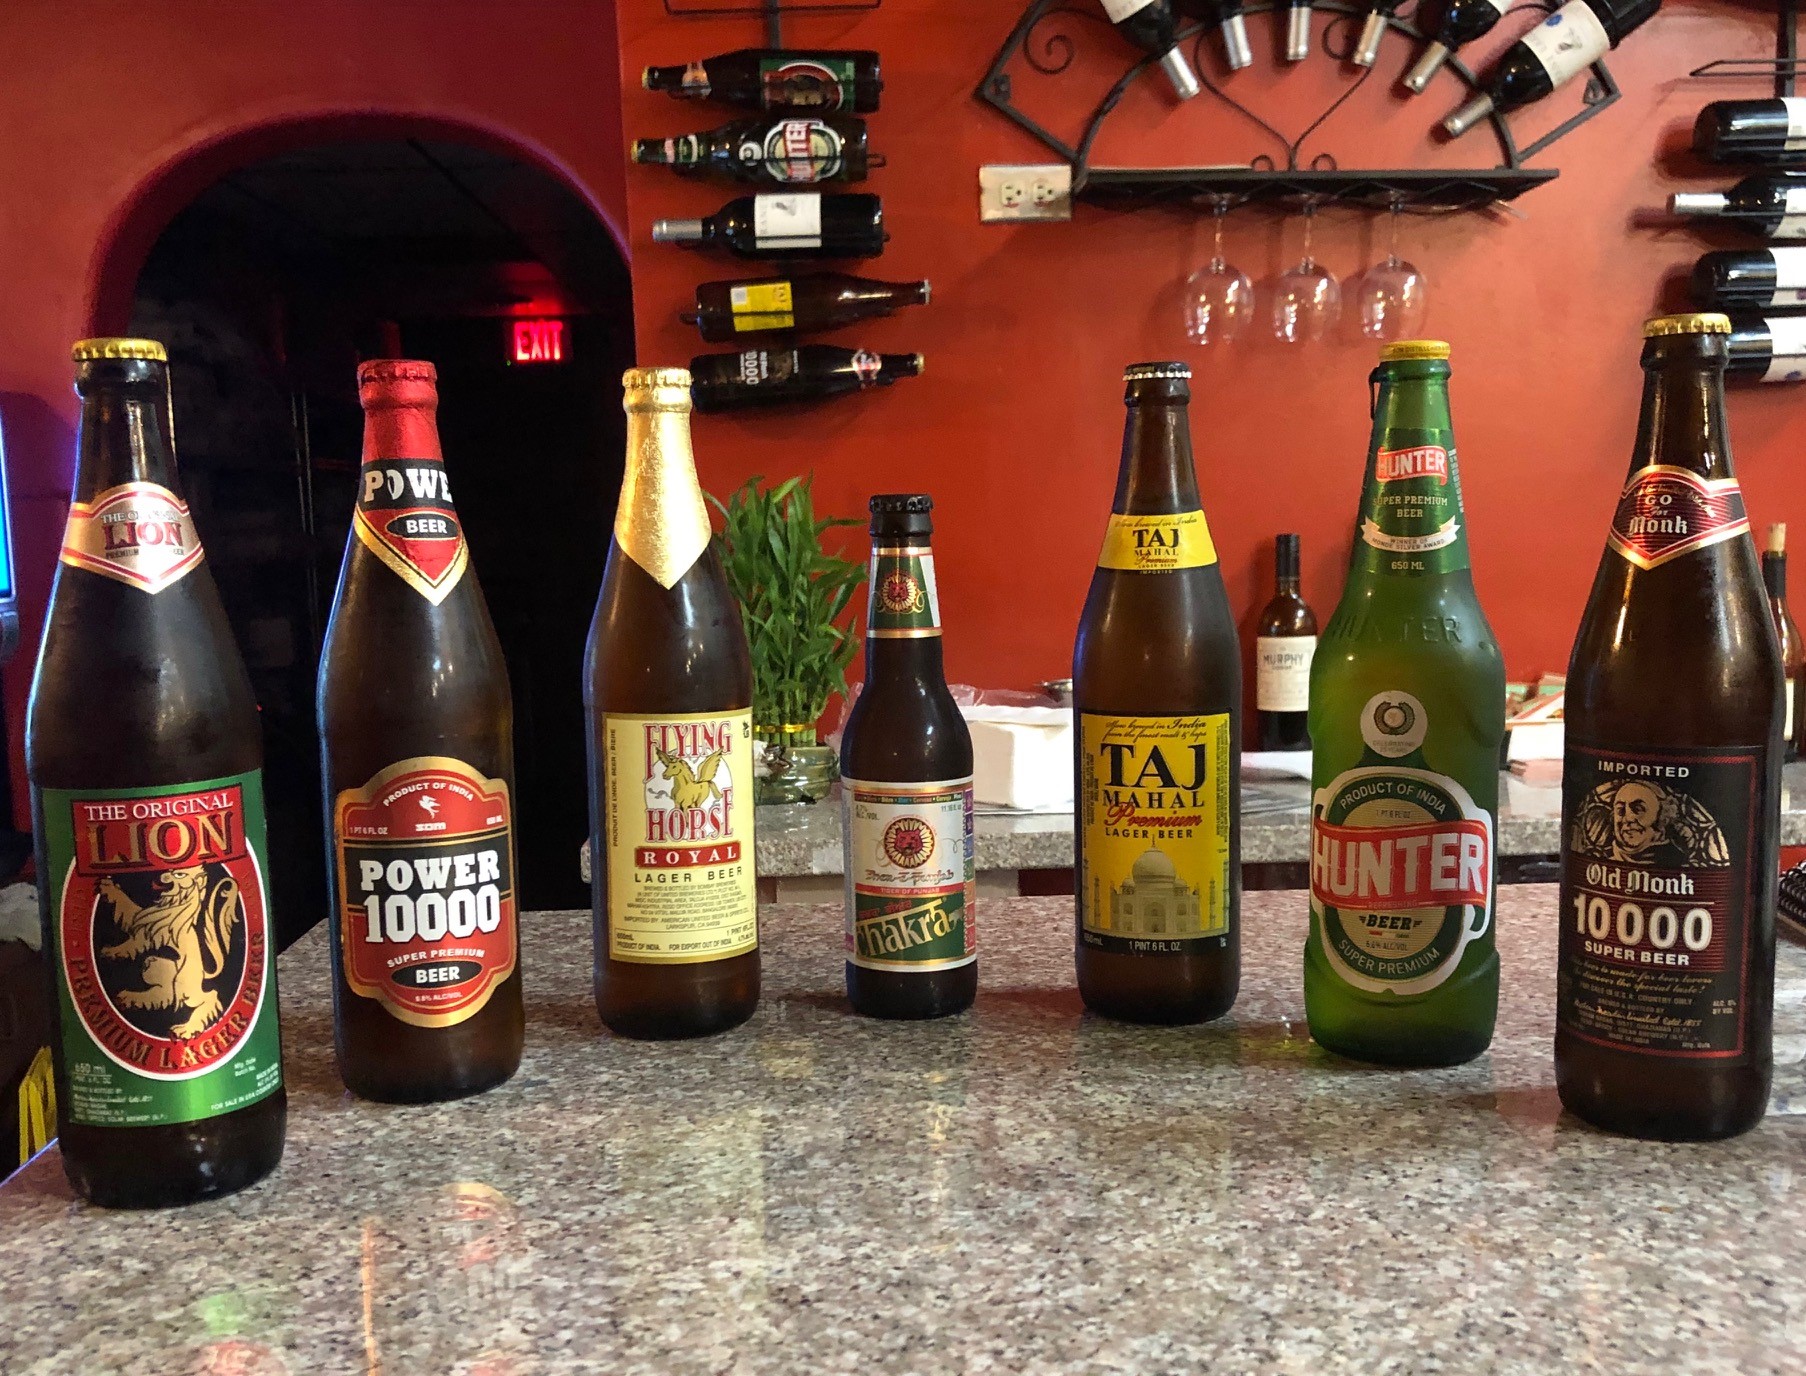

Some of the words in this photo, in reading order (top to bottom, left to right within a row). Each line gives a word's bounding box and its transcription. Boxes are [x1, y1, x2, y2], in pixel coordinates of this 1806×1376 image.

[514, 321, 563, 360] EXIT
[1374, 496, 1402, 506] SUPER
[1404, 496, 1448, 506] PREMIUM
[1645, 494, 1672, 505] GO
[101, 512, 126, 523] THE
[1396, 509, 1423, 518] BEER
[406, 520, 448, 534] BEER
[1628, 516, 1688, 536] Monk
[103, 522, 183, 550] LION
[1132, 528, 1179, 548] TAJ
[1423, 539, 1444, 549] AWARD
[1134, 548, 1178, 556] MAHAL
[1392, 562, 1409, 570] 650
[1411, 562, 1424, 570] ML
[1264, 654, 1304, 665] MURPHY
[1167, 718, 1206, 730] India
[643, 721, 732, 783] FLYING
[1100, 743, 1207, 790] TAJ
[1598, 760, 1690, 778] IMPORTED
[383, 782, 430, 806] PRODUCT
[432, 782, 446, 790] OF
[449, 784, 474, 802] INDIA
[1102, 790, 1204, 808] MAHAL
[1340, 782, 1392, 810] PRODUCT
[1397, 783, 1414, 796] OF
[1416, 790, 1447, 814] INDIA
[84, 804, 128, 822] THE
[132, 792, 234, 818] ORIGINAL
[612, 802, 618, 813] DE
[646, 788, 734, 842] HORSE
[1104, 802, 1202, 828] Premium
[87, 810, 233, 868] LION
[1106, 828, 1148, 838] LAGER
[1158, 830, 1192, 838] BEER
[643, 846, 737, 864] ROYAL
[1314, 831, 1484, 897] HUNTER
[360, 850, 500, 892] POWER
[634, 873, 692, 883] LAGER
[707, 866, 742, 880] BEER
[1586, 862, 1622, 890] Old
[1625, 870, 1694, 896] Monk
[364, 884, 500, 942] 10000
[1366, 914, 1413, 930] BEER
[1574, 892, 1712, 951] 10000
[617, 941, 638, 950] PRODUCT
[680, 942, 702, 950] EXPORT
[1134, 942, 1151, 950] PINT
[1152, 942, 1158, 950] 6
[1584, 940, 1635, 962] SUPER
[1640, 951, 1690, 966] BEER
[386, 950, 428, 968] SUPER
[430, 948, 485, 958] PREMIUM
[1339, 940, 1374, 971] SUPER
[1378, 948, 1440, 974] PREMIUM
[416, 966, 460, 984] BEER
[70, 956, 152, 1067] PREMIUM
[158, 1010, 250, 1072] LAGER
[211, 1102, 223, 1110] FOR
[225, 1098, 237, 1107] SALE
